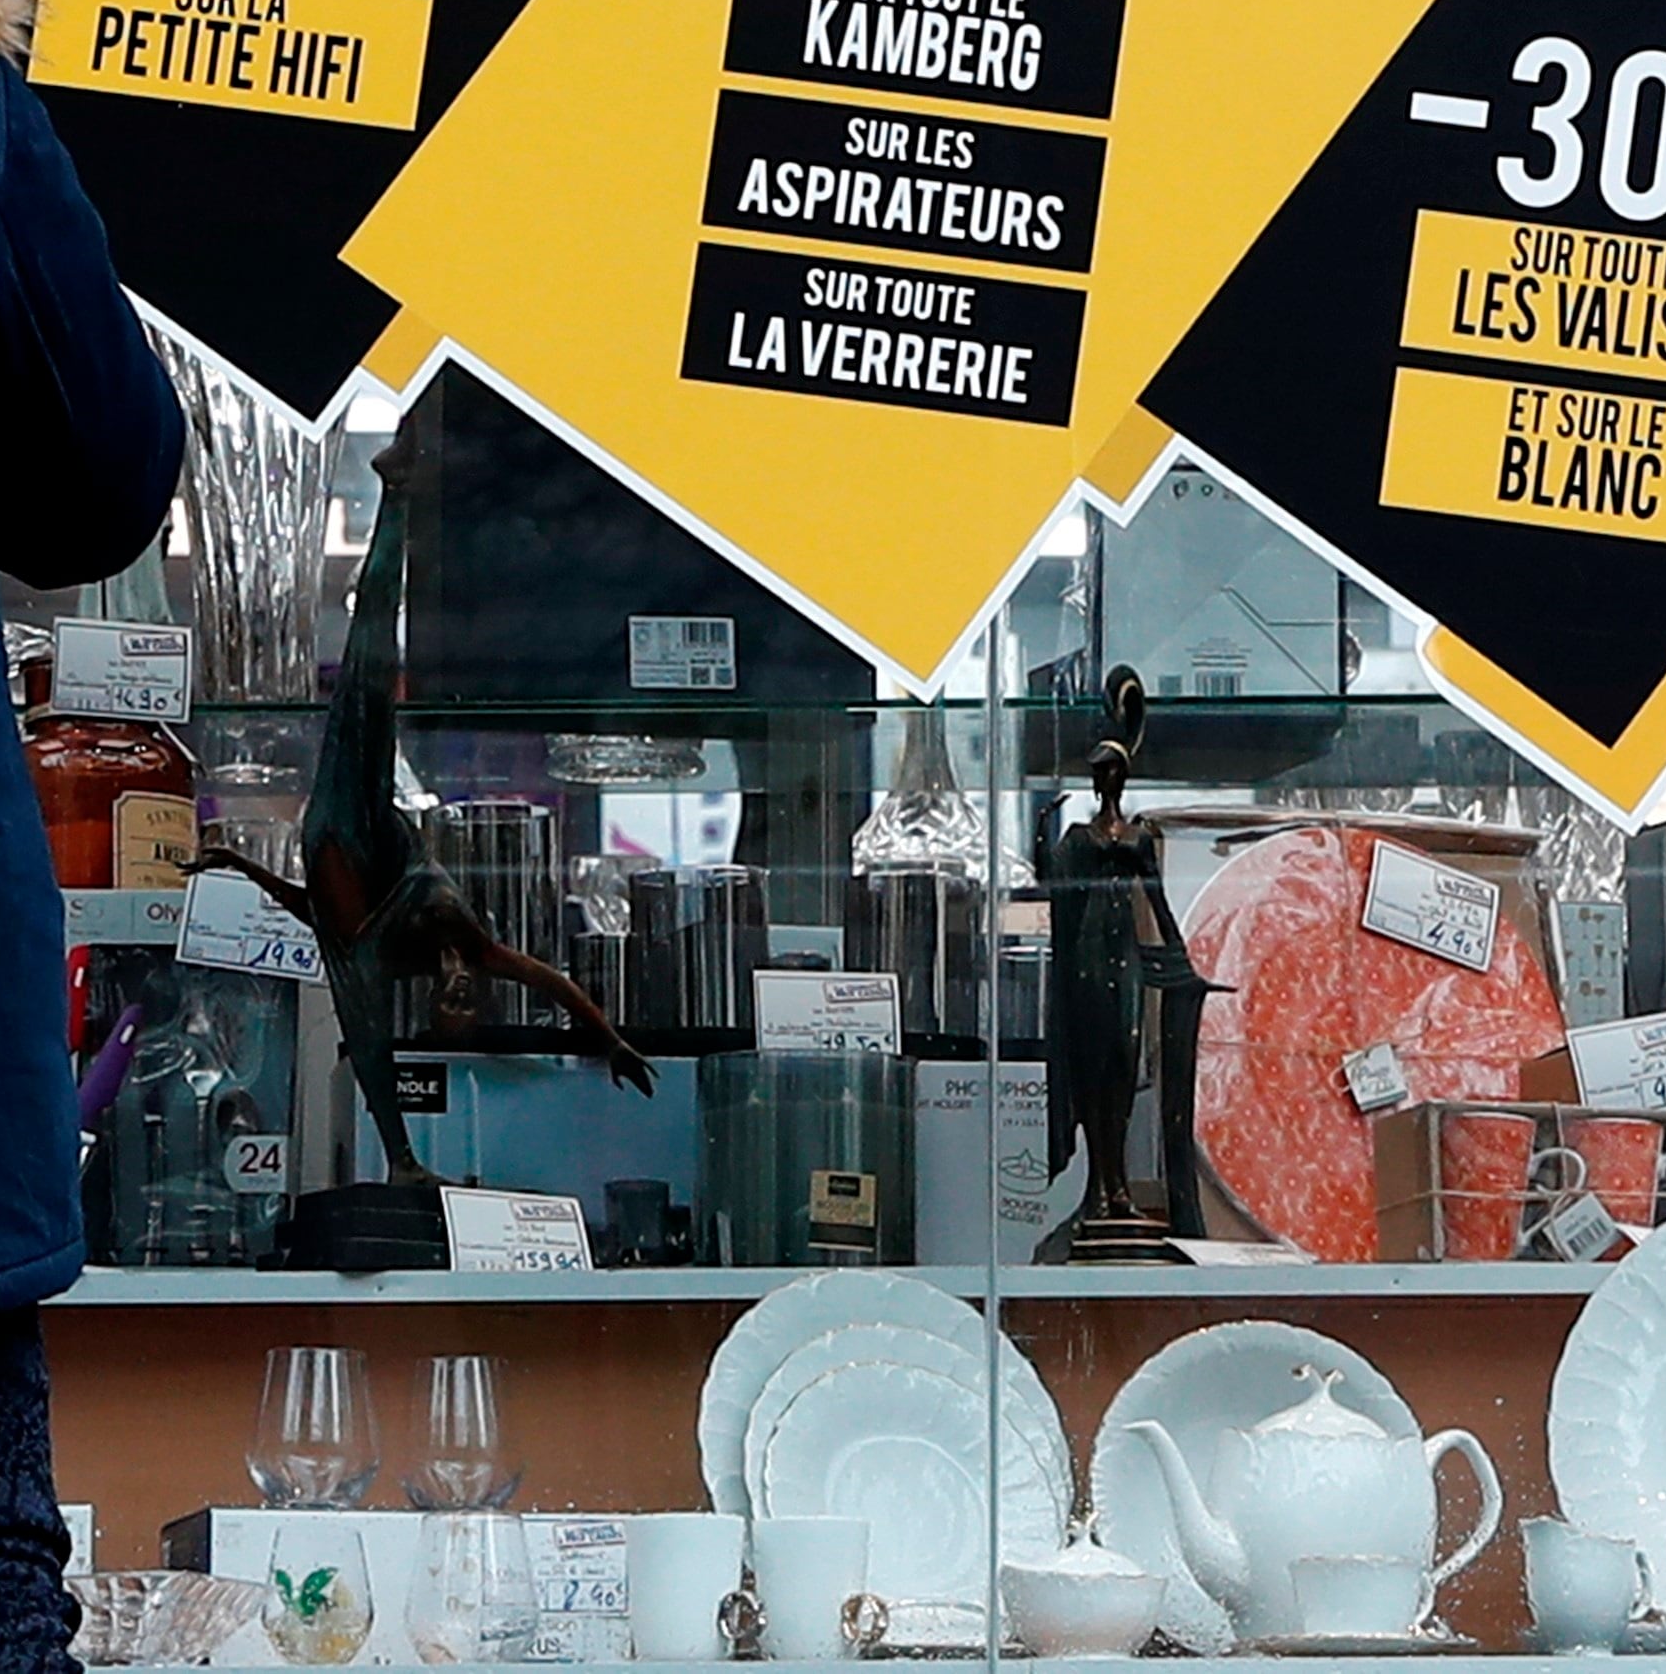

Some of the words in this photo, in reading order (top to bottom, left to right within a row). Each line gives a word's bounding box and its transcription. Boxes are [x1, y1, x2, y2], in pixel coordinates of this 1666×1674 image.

[92, 7, 260, 91] PETITE
[269, 30, 364, 103] HIFI
[845, 118, 909, 164] SUR
[916, 125, 974, 169] LES
[738, 158, 1065, 250] ASPIRATEURS
[1511, 227, 1573, 277] SUR
[804, 268, 866, 311] SUR
[875, 276, 975, 326] TOUTE
[1453, 269, 1542, 344] LES
[729, 311, 786, 372] LA
[801, 321, 1033, 403] VERRERIE
[1509, 387, 1550, 433] ET
[1557, 393, 1621, 443] SUR
[1628, 402, 1666, 450] LE
[1497, 434, 1662, 519] BLANC
[240, 1142, 282, 1173] 24
